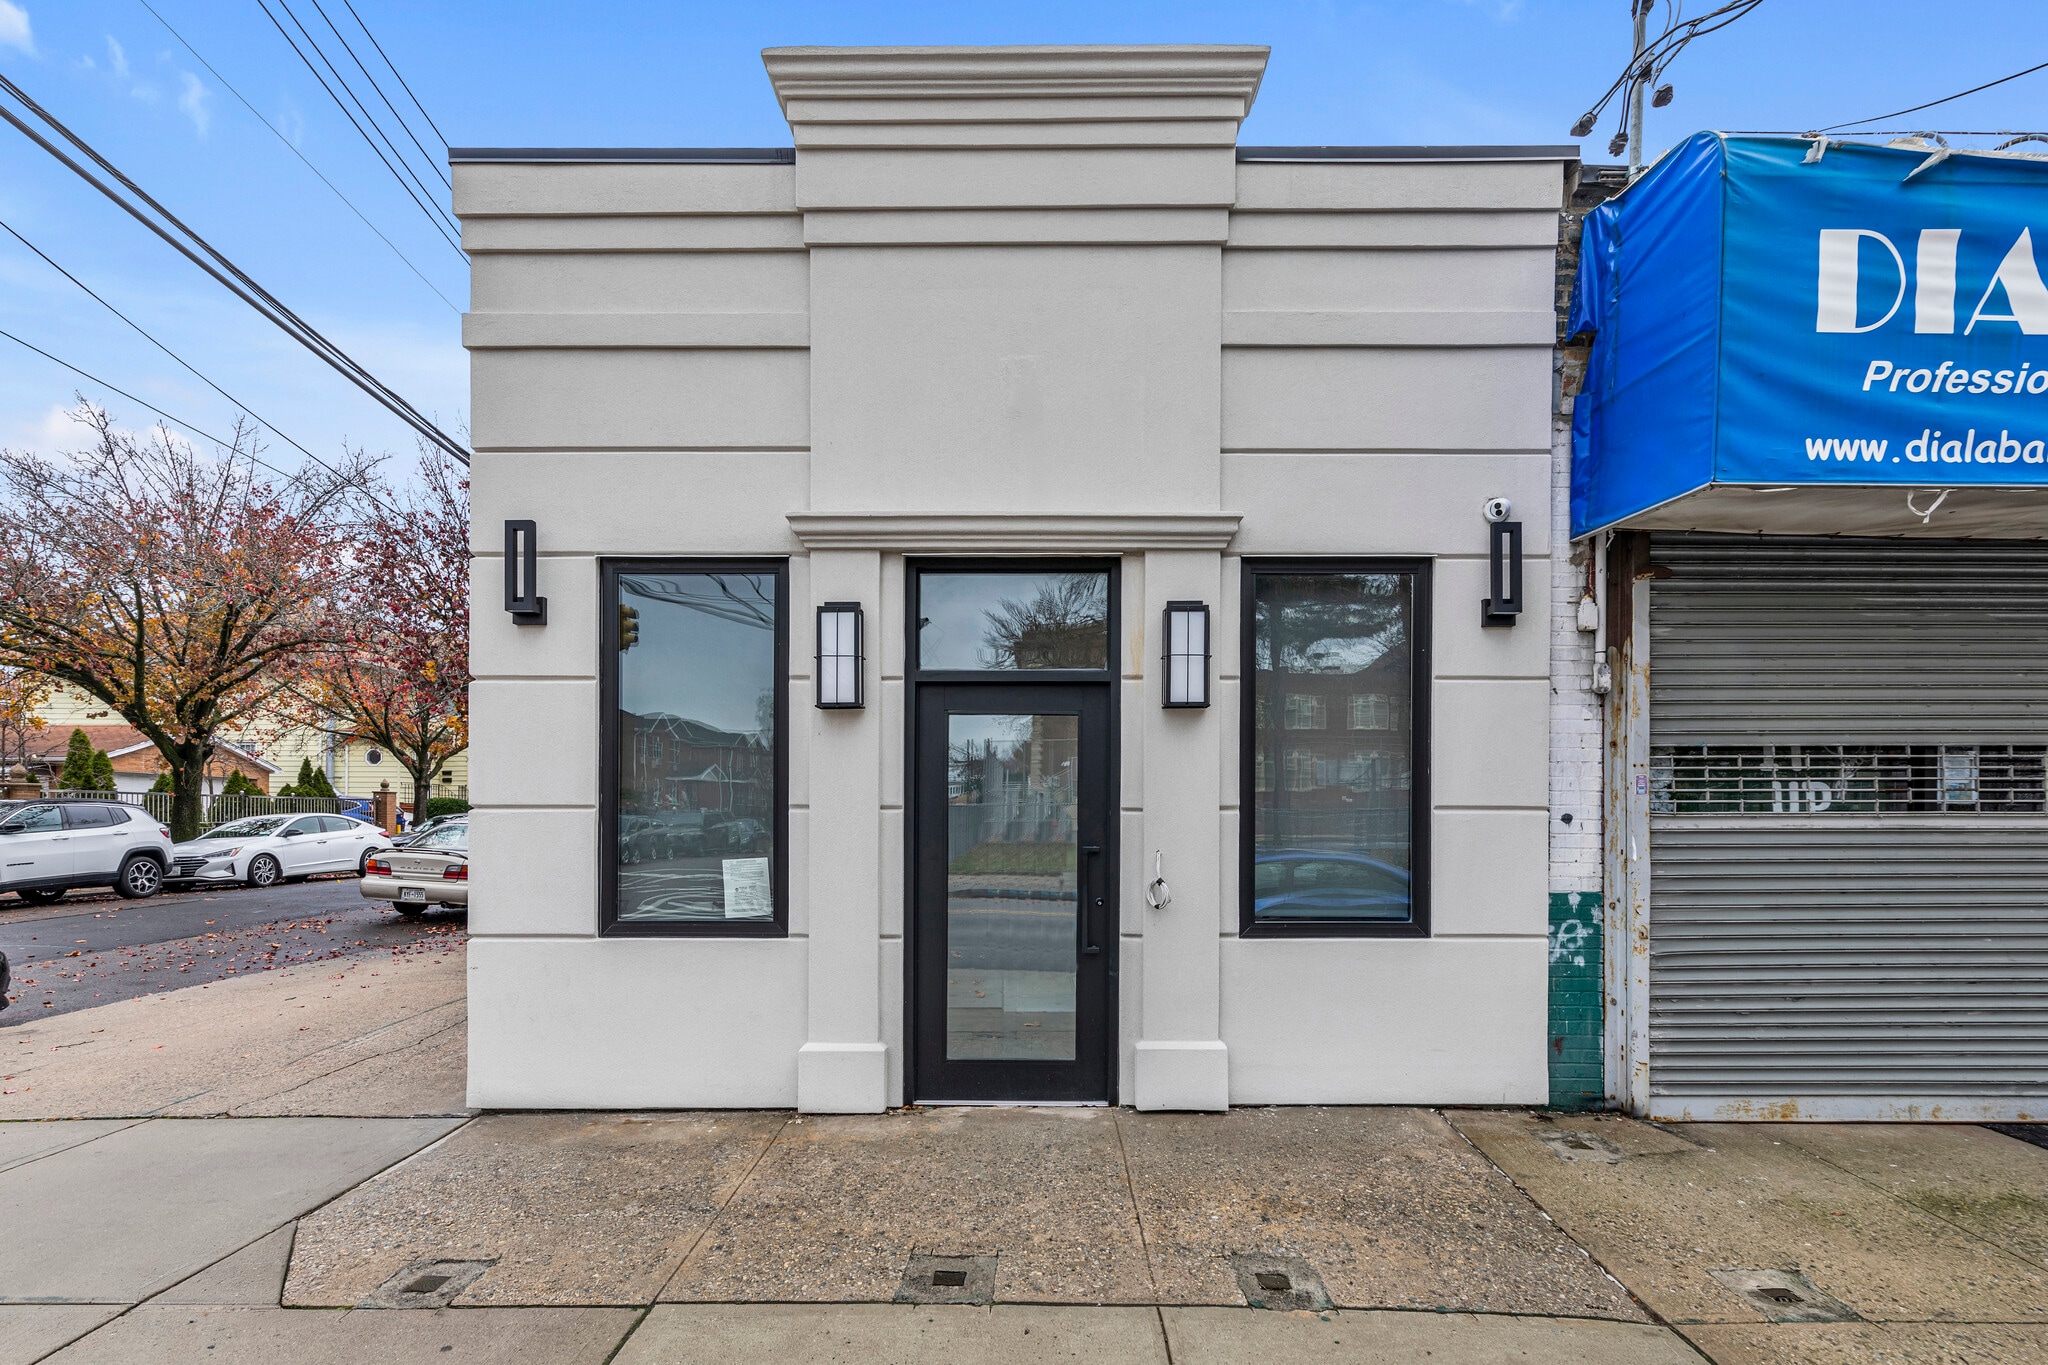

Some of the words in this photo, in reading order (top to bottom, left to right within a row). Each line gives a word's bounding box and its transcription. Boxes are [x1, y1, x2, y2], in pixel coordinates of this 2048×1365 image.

[1816, 226, 2048, 336] DIA
[1862, 360, 2048, 394] Professio
[1805, 428, 2048, 464] www.dialaba
